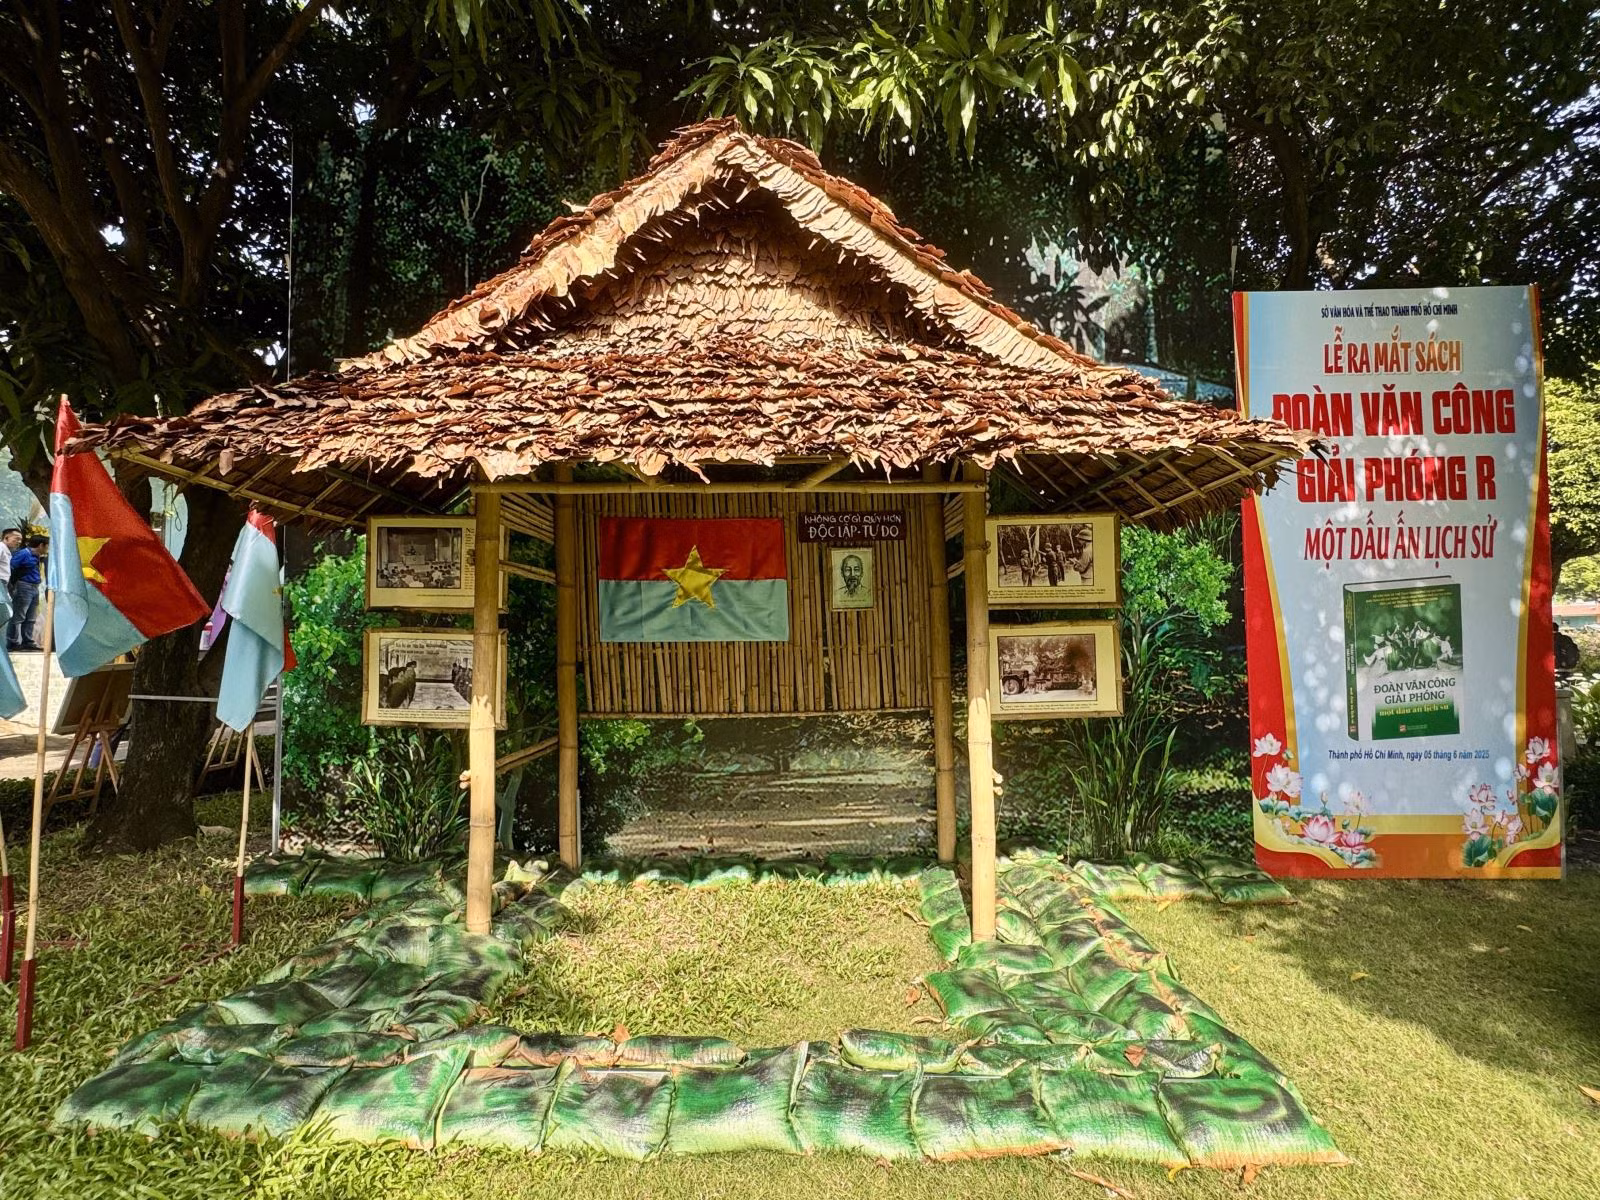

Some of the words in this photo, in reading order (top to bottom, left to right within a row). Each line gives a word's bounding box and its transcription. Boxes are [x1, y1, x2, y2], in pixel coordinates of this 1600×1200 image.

[1342, 305, 1354, 318] HÓA
[1355, 304, 1364, 317] VÀ
[1364, 302, 1374, 316] THẾ
[1375, 306, 1390, 316] THAO
[1391, 304, 1410, 316] THÀNH
[1411, 303, 1422, 316] PHỐ
[1424, 302, 1432, 316] HỒ
[1432, 303, 1442, 315] CHÍ
[1443, 304, 1458, 315] MINH
[1324, 325, 1344, 374] LỄ
[1347, 342, 1371, 374] RA
[1374, 324, 1412, 373] MẮT
[1415, 331, 1461, 372] SÁCH
[1272, 384, 1354, 436] ĐOÀN
[1360, 383, 1424, 436] VĂN
[1432, 382, 1516, 434] CÔNG
[1296, 444, 1356, 502] GIẢI
[1364, 448, 1467, 502] PHÓNG
[1476, 455, 1497, 500] R
[804, 514, 837, 524] KHÔNG
[808, 524, 836, 540] ĐỘC
[881, 525, 899, 538] DO
[1304, 518, 1347, 569] MỘT
[1350, 510, 1389, 560] DẤU
[1393, 510, 1421, 560] ẤN
[1425, 525, 1467, 569] LỊCH
[1471, 514, 1498, 559] SỬ
[1374, 681, 1404, 694] ĐOÀN
[1405, 680, 1426, 690] VĂN
[1428, 677, 1456, 688] CÔNG
[1384, 692, 1406, 704] GIẢI
[1409, 690, 1445, 702] PHÓNG
[1328, 750, 1348, 760] Thành
[1350, 749, 1362, 761] phố
[1364, 748, 1374, 760] Hồ
[1374, 750, 1386, 760] Chí
[1387, 750, 1405, 760] Minh,
[1406, 750, 1422, 762] ngày
[1424, 750, 1432, 760] 05
[1433, 750, 1451, 762] tháng
[1453, 750, 1458, 760] 6
[1458, 750, 1473, 760] năm
[1474, 750, 1490, 759] 2025
